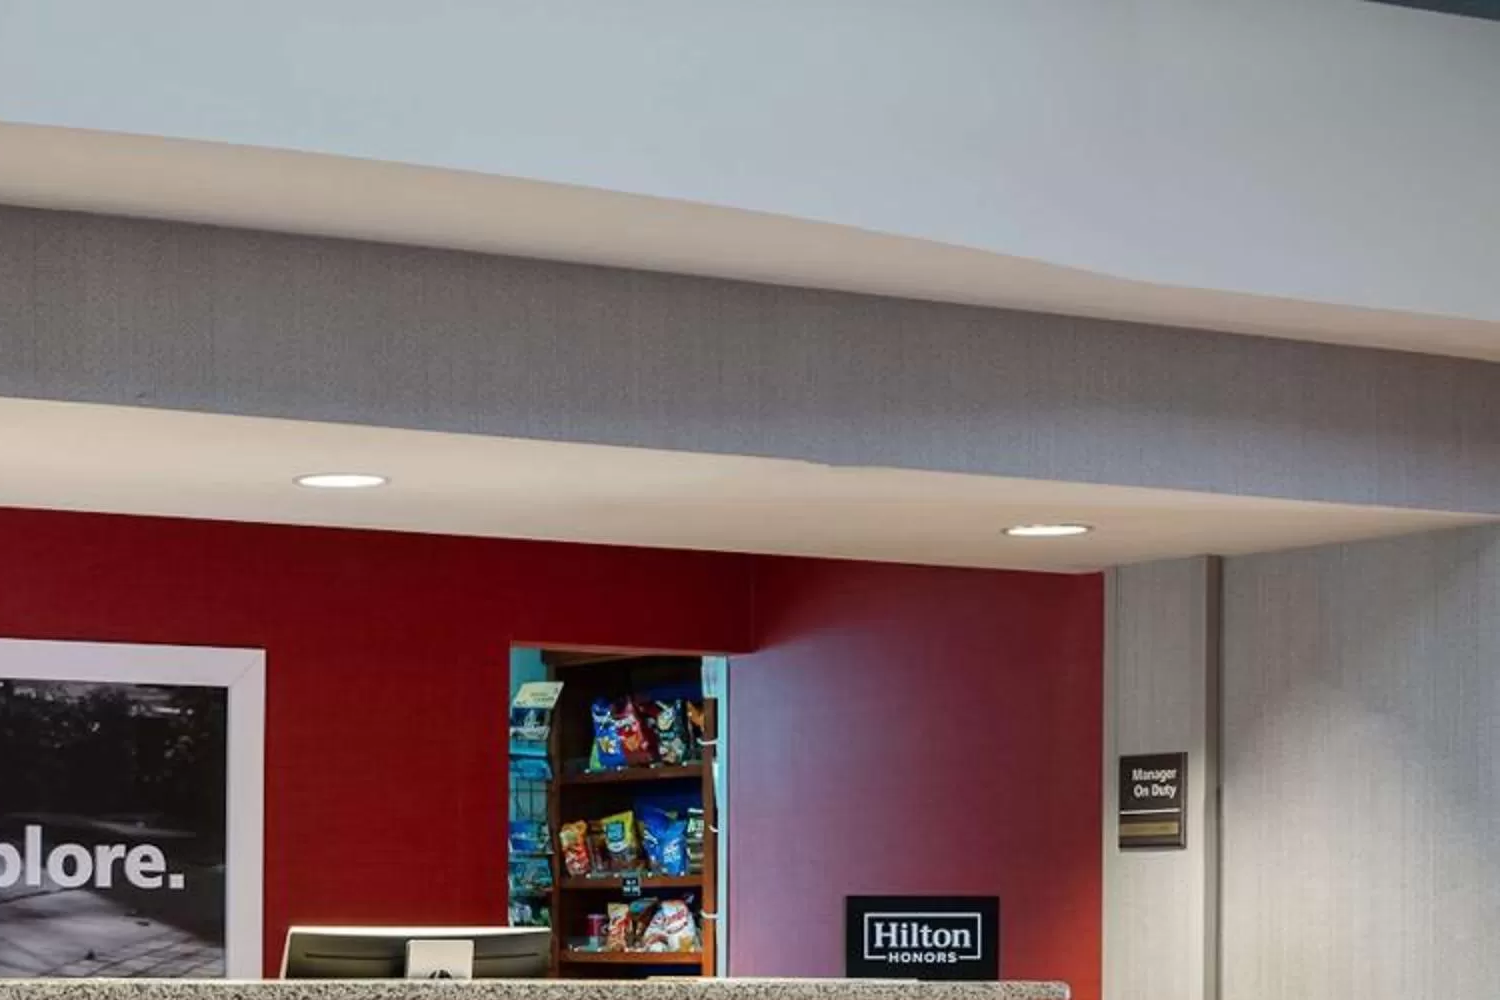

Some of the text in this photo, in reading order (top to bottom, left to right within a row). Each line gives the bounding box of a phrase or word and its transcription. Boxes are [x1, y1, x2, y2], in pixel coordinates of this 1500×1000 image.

[1132, 768, 1177, 783] Manager
[1133, 784, 1177, 799] On Duty
[873, 922, 971, 948] Hilton
[888, 951, 958, 963] HONORS
